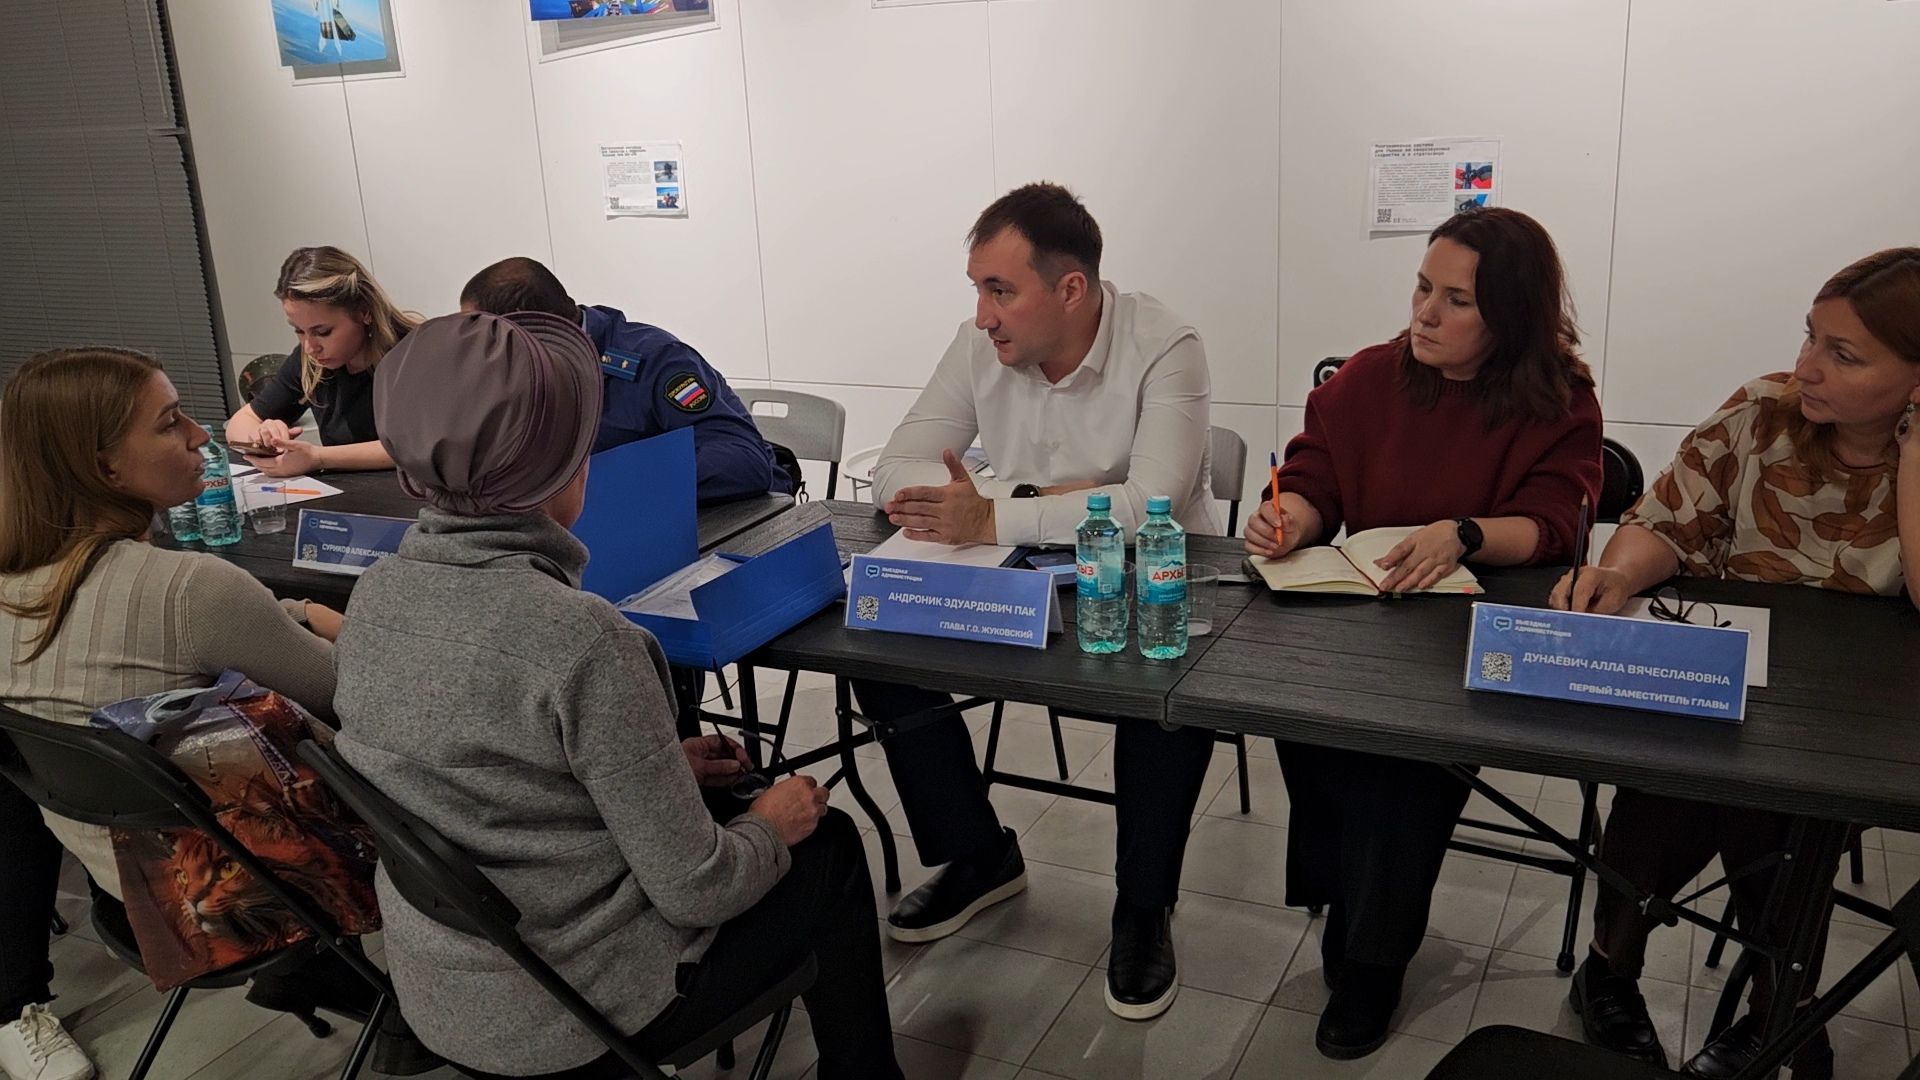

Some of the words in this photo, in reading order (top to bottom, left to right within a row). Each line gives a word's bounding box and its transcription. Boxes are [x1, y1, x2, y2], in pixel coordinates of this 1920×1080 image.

[202, 477, 228, 487] РХЫЗ
[888, 591, 943, 607] АНДРОНИК
[944, 597, 1012, 615] ЭДУАРДОВИЧ
[1014, 605, 1037, 617] ПАК
[939, 621, 966, 632] ГЛАВА
[966, 624, 980, 634] Г.О.
[981, 626, 1034, 640] ЖУКОВСКИЙ
[1522, 651, 1589, 669] ДУНАЕВИЧ
[1590, 660, 1625, 674] АЛЛА
[1627, 664, 1731, 686] ВЯЧЕСЛАВОВНА
[1568, 682, 1613, 696] ПЕРВЫЙ
[1614, 688, 1690, 706] ЗАМЕСТИТЕЛЬ
[1691, 697, 1730, 711] ГЛАВЫ
